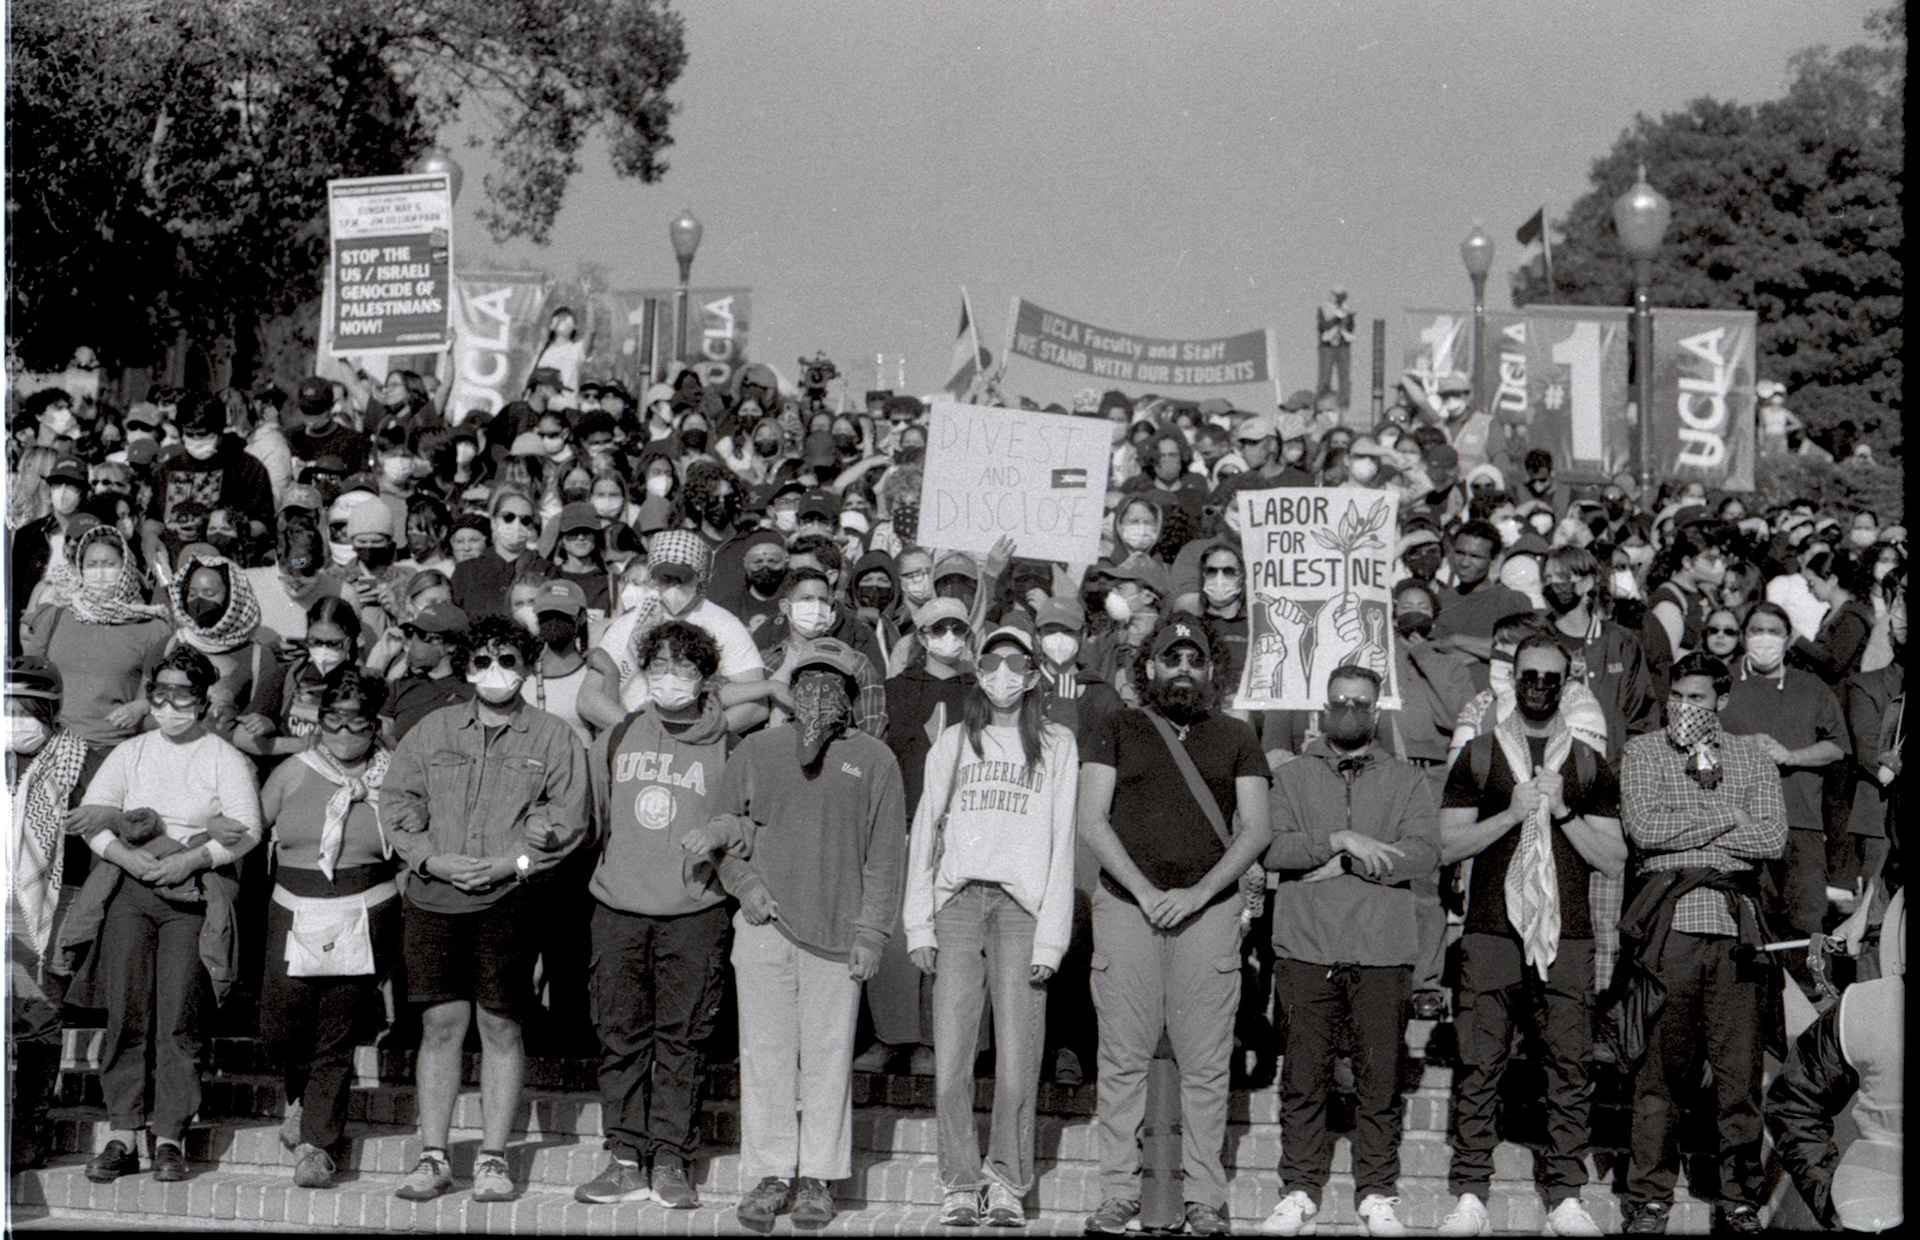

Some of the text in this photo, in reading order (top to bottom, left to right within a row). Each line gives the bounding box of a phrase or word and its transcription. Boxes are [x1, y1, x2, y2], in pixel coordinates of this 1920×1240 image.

[341, 246, 411, 265] STOP THE
[341, 268, 361, 282] US
[377, 263, 430, 280] ISRAELI
[341, 281, 435, 299] GENOCIDE OF
[341, 300, 442, 317] PALESTINIANS
[340, 319, 383, 336] NOW!
[1041, 314, 1226, 361] UCLA Faculty and Staff
[1038, 340, 1088, 370] STAND
[1092, 356, 1133, 378] WITH
[1137, 363, 1169, 382] OUR
[1173, 361, 1255, 383] STUDENTS
[1545, 322, 1603, 461] #1
[1677, 327, 1726, 466] UCLA
[941, 415, 1083, 465] DIVEST
[978, 466, 1021, 488] AND
[936, 488, 1088, 539] DISCLOSE
[1249, 496, 1329, 528] LABOR
[1267, 530, 1305, 554] FOR
[616, 751, 707, 797] UCLA
[959, 761, 1043, 793] WITZERLAND
